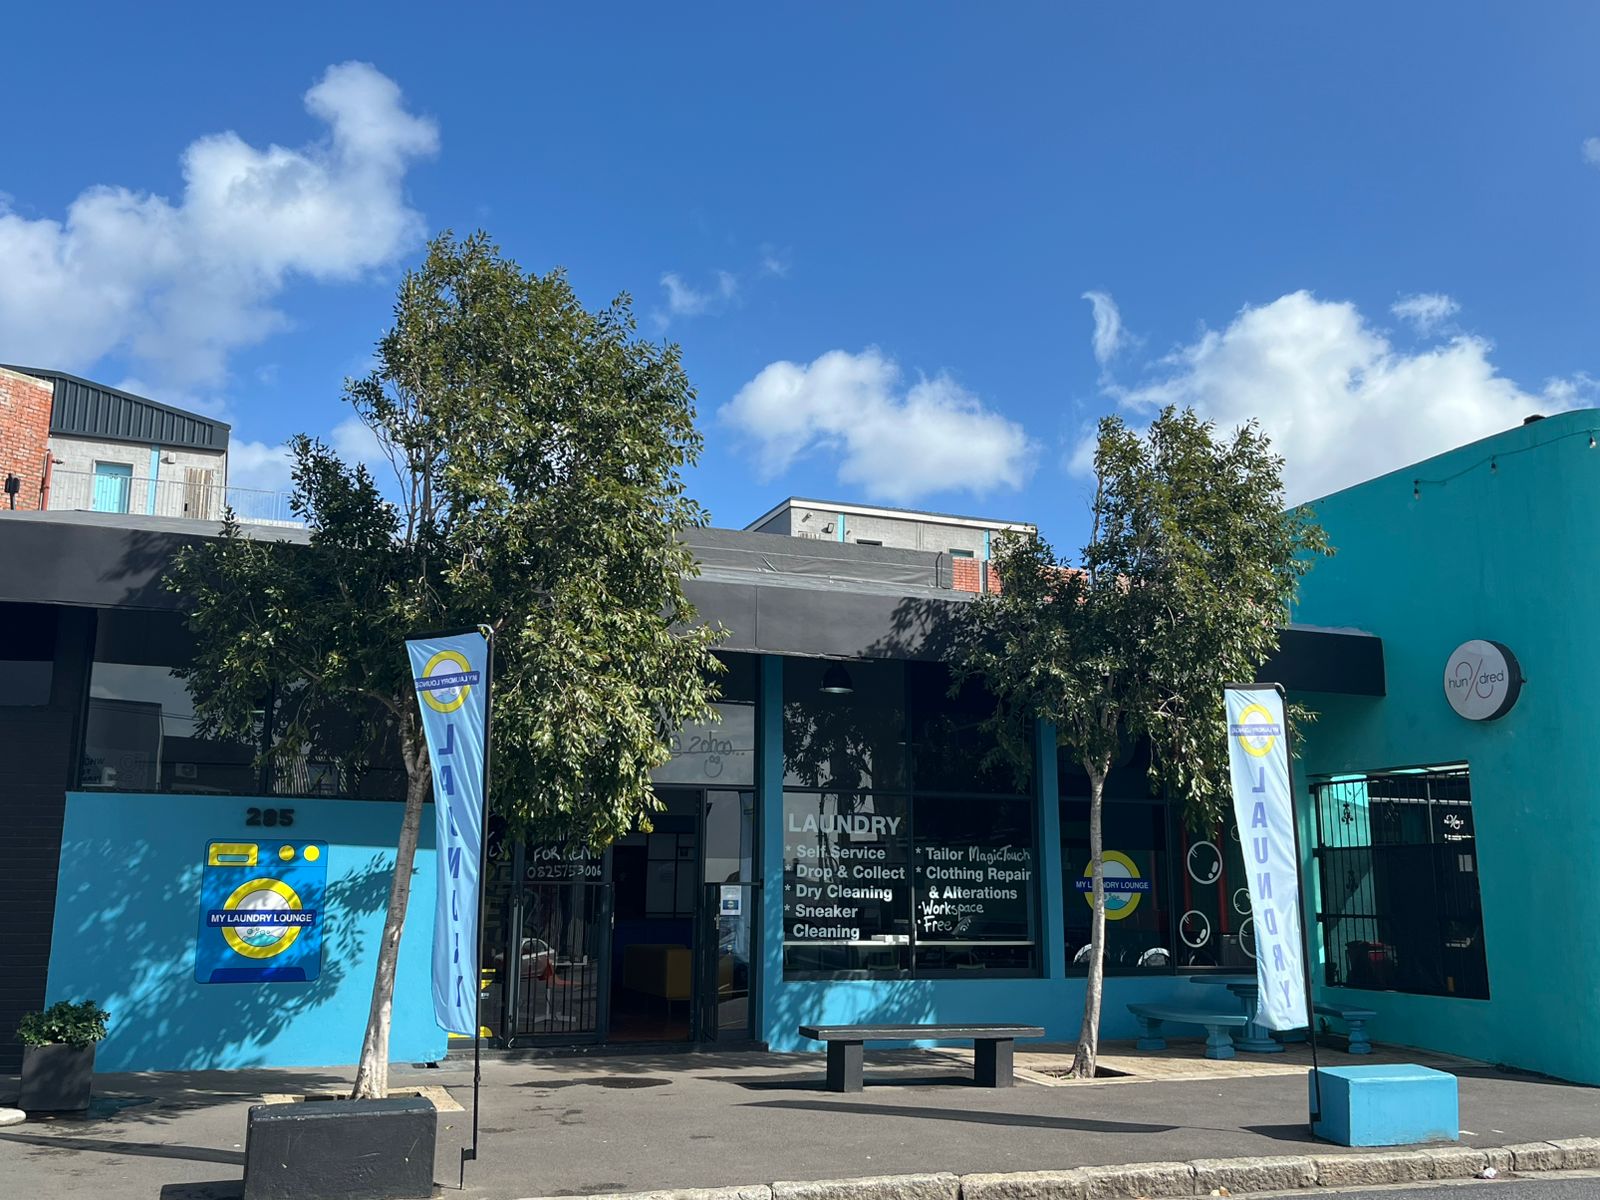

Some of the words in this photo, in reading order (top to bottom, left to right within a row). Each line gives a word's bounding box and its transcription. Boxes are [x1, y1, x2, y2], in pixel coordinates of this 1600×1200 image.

[788, 814, 902, 836] LAUNDRY
[533, 845, 560, 862] FOR
[830, 845, 887, 860] Service
[925, 847, 964, 861] Tailor
[796, 865, 832, 880] Drop
[837, 866, 848, 879] &
[853, 866, 906, 880] Collect
[926, 867, 983, 883] Clothing
[987, 868, 1032, 883] Repair
[1087, 881, 1119, 889] LNDRY
[795, 885, 823, 901] Dry
[827, 885, 893, 902] Cleaning
[928, 886, 939, 899] &
[942, 887, 1018, 900] Alterations
[211, 915, 225, 923] MY
[227, 914, 272, 923] LAUNDRY
[274, 914, 313, 923] LOUNGE
[795, 905, 858, 918] Sneaker
[793, 924, 860, 940] Cleaning
[923, 917, 952, 933] Free
